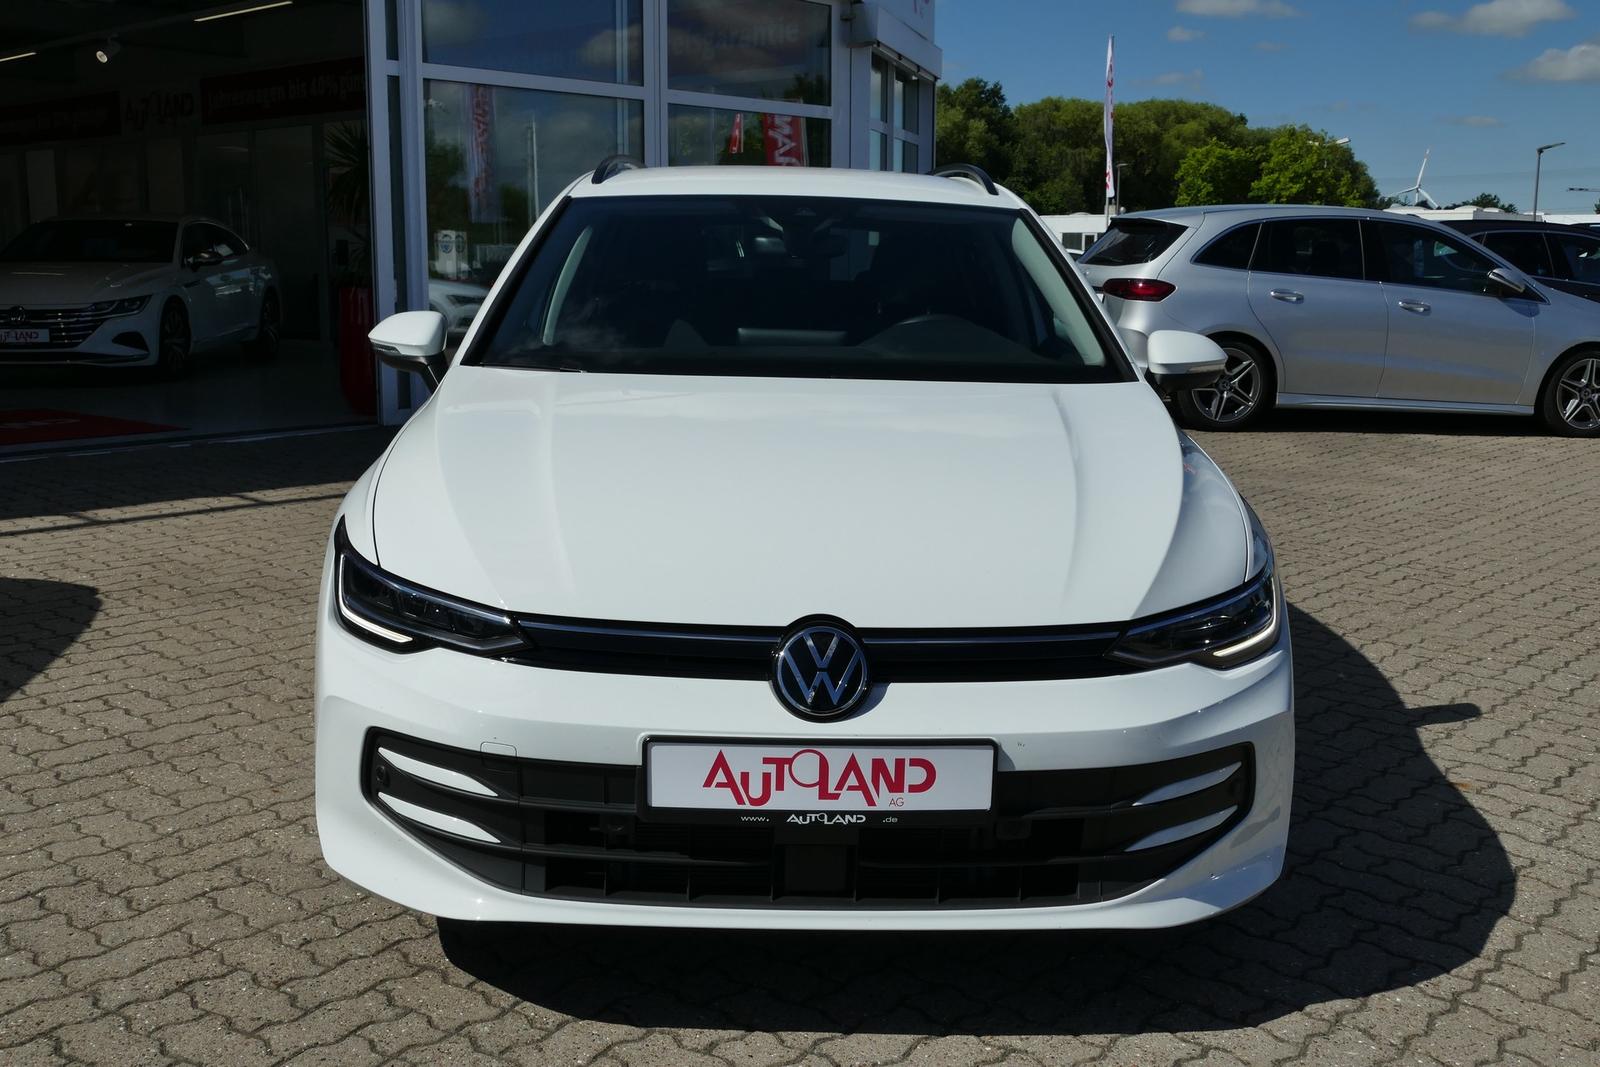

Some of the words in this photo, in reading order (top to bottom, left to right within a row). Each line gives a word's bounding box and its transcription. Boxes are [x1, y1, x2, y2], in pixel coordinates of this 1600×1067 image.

[288, 78, 307, 99] bis
[309, 74, 338, 97] 40%
[703, 749, 937, 807] AUTOLAND
[888, 796, 905, 808] AG
[786, 812, 867, 825] AUTOLAND
[882, 815, 898, 823] .de
